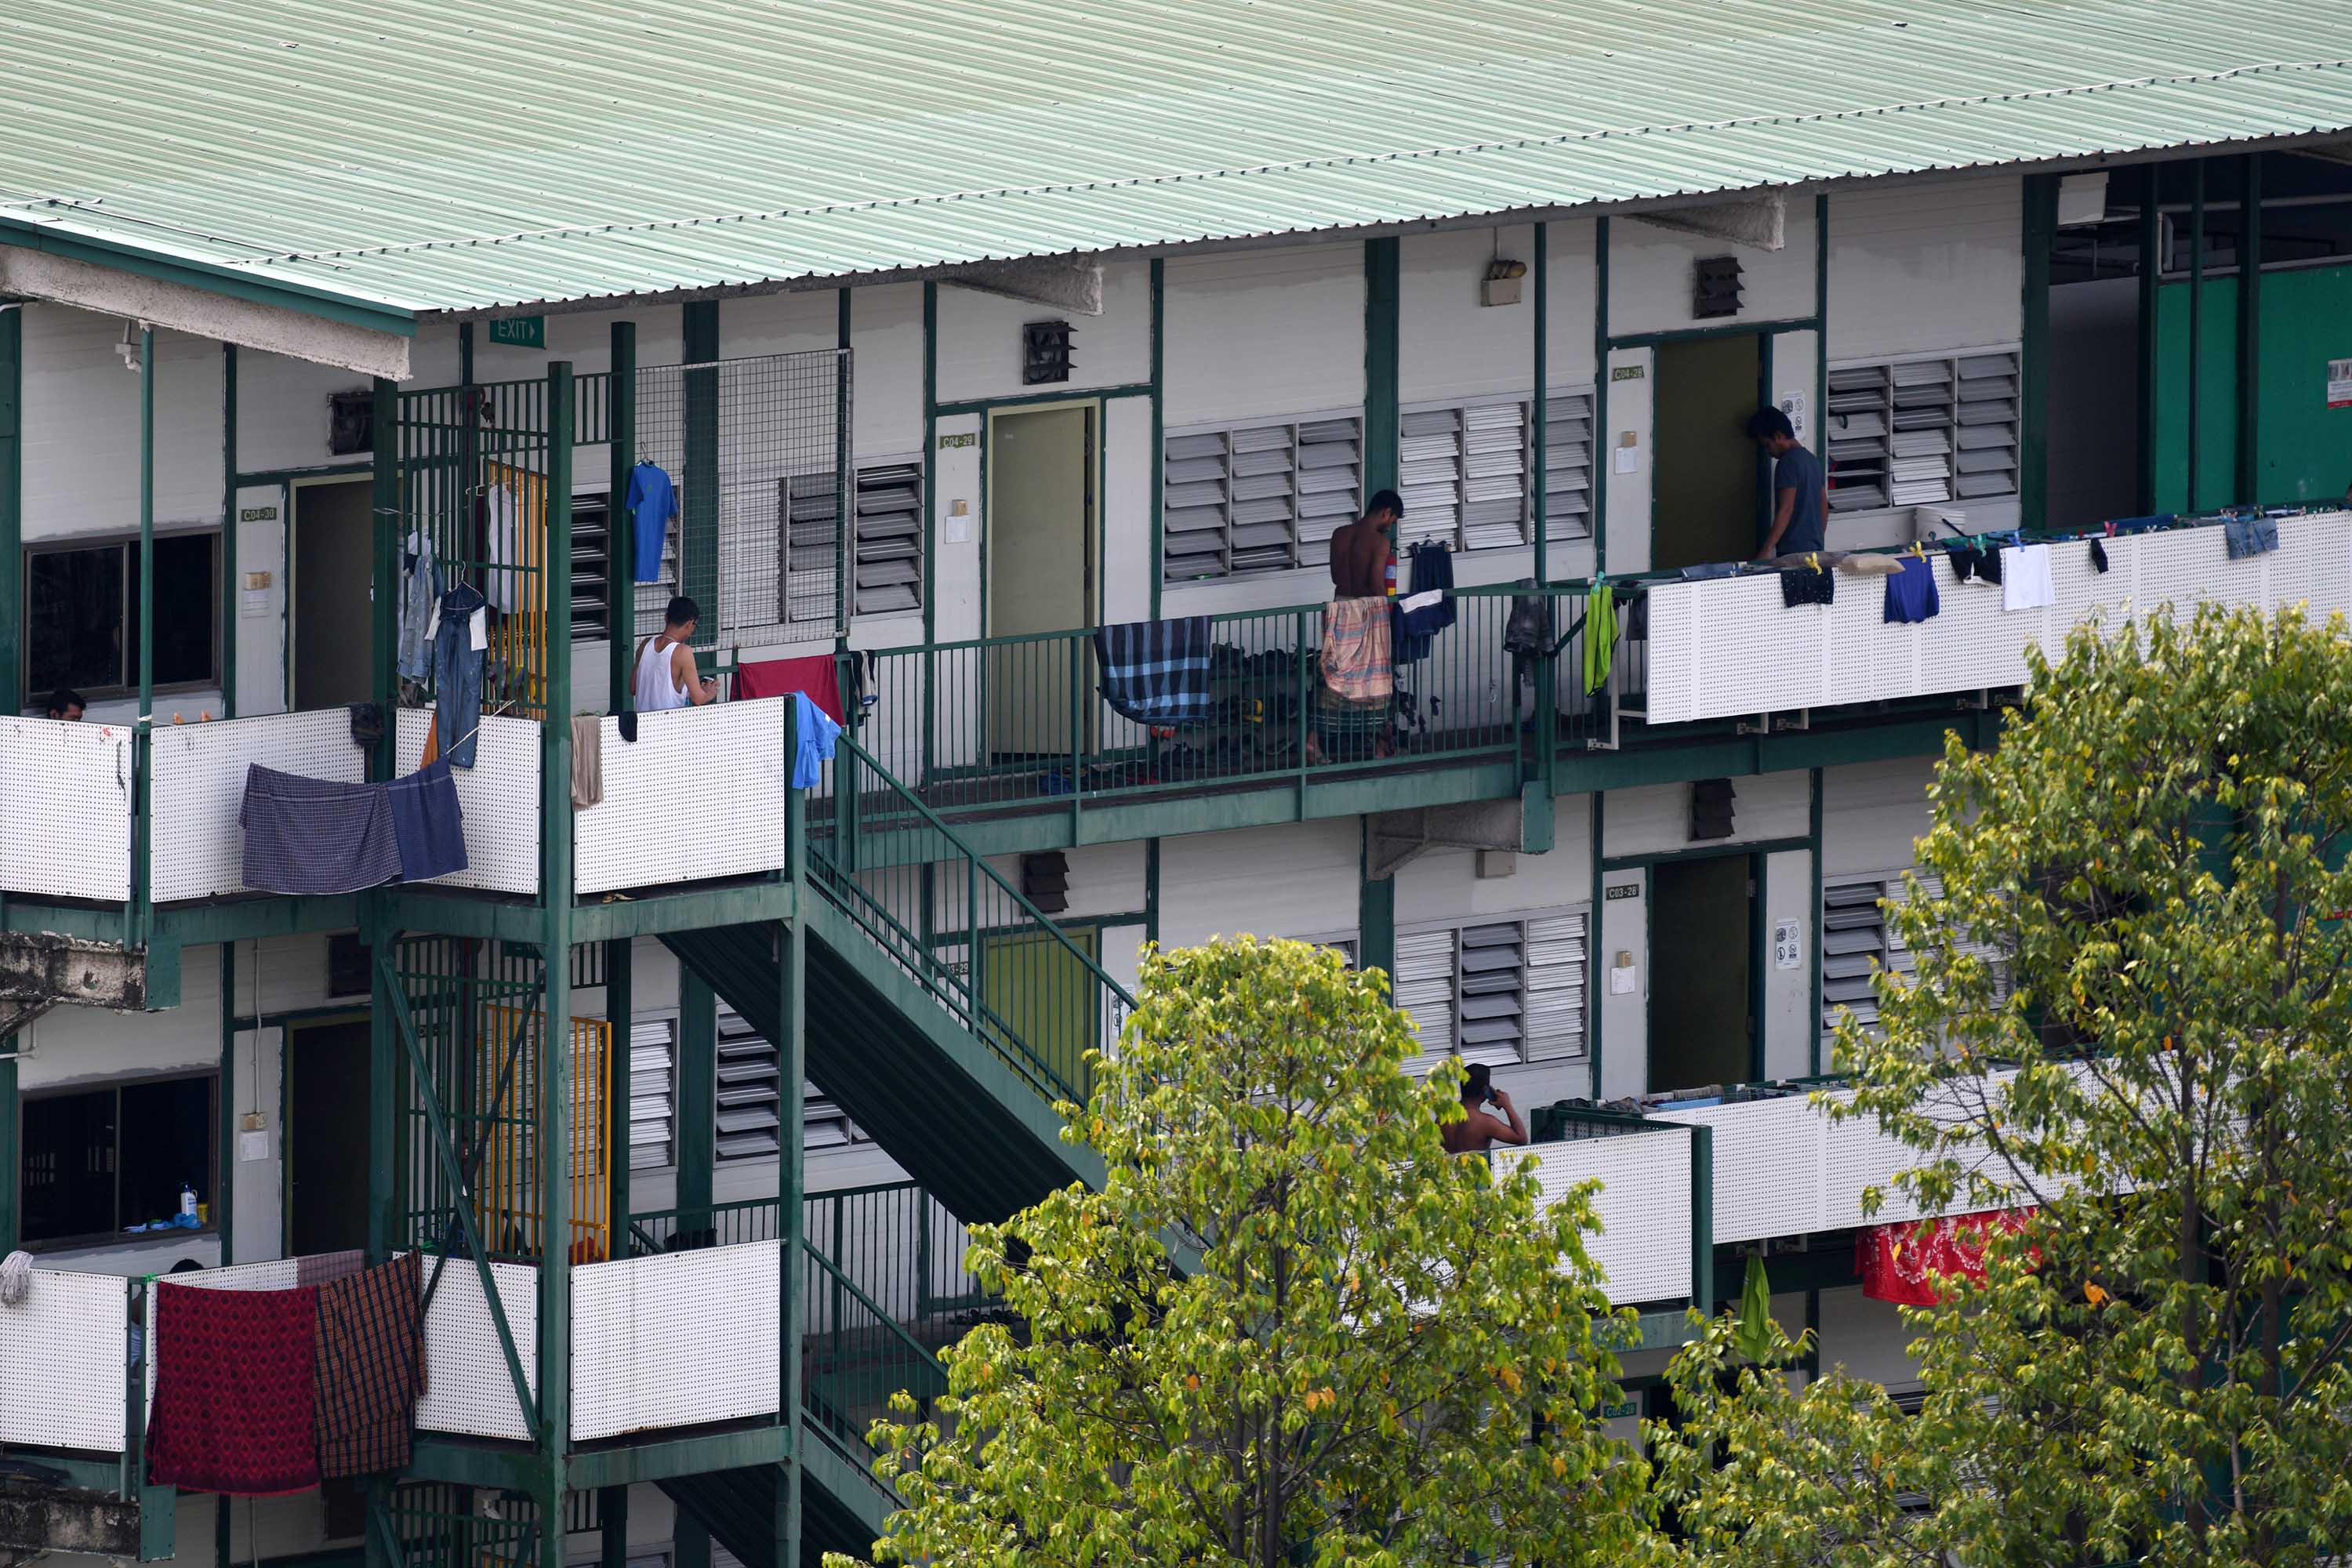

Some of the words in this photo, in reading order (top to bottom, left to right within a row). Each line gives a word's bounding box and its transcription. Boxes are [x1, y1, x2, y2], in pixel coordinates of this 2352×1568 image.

[499, 320, 527, 339] EXIT
[1615, 368, 1642, 379] C04-28
[943, 435, 972, 447] C04-29
[244, 509, 274, 521] C04-30
[1609, 886, 1637, 898] C03-28
